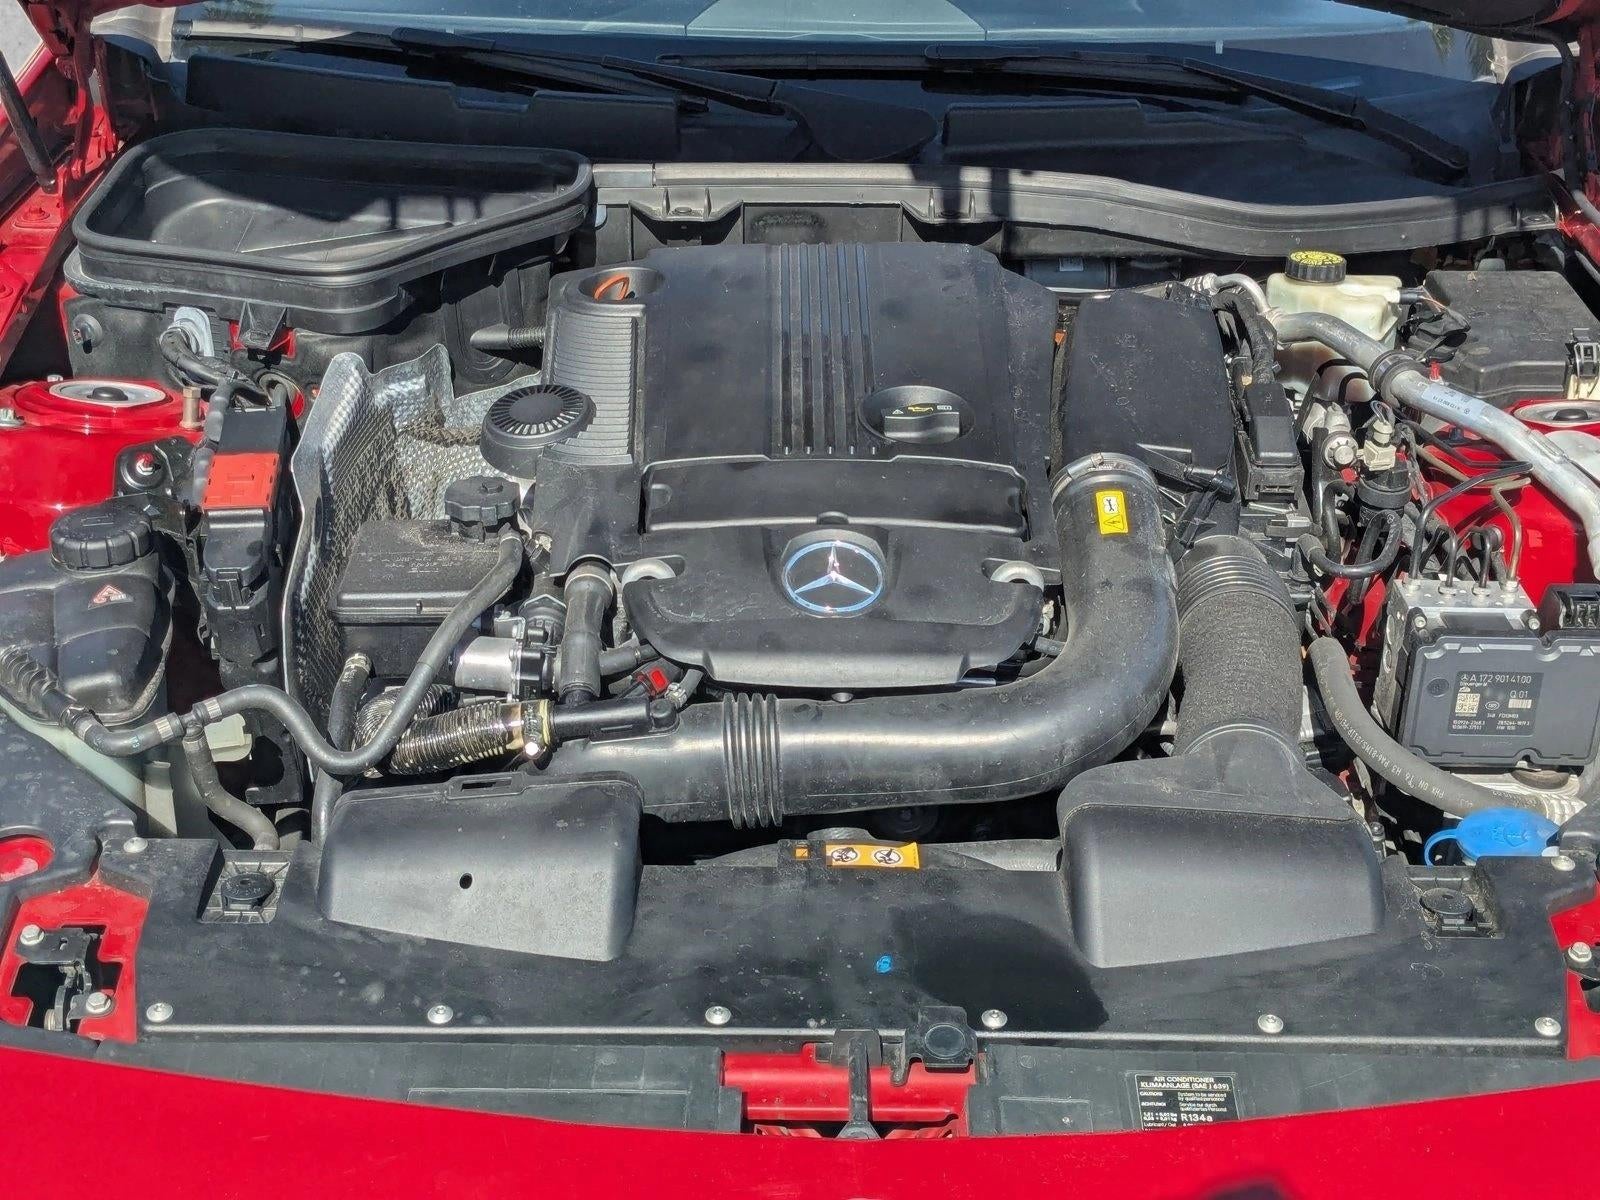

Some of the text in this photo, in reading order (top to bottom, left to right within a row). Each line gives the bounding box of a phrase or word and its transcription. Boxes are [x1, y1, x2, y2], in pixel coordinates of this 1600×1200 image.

[1469, 674, 1477, 683] A
[1479, 674, 1493, 683] 172
[1518, 690, 1528, 699] 01
